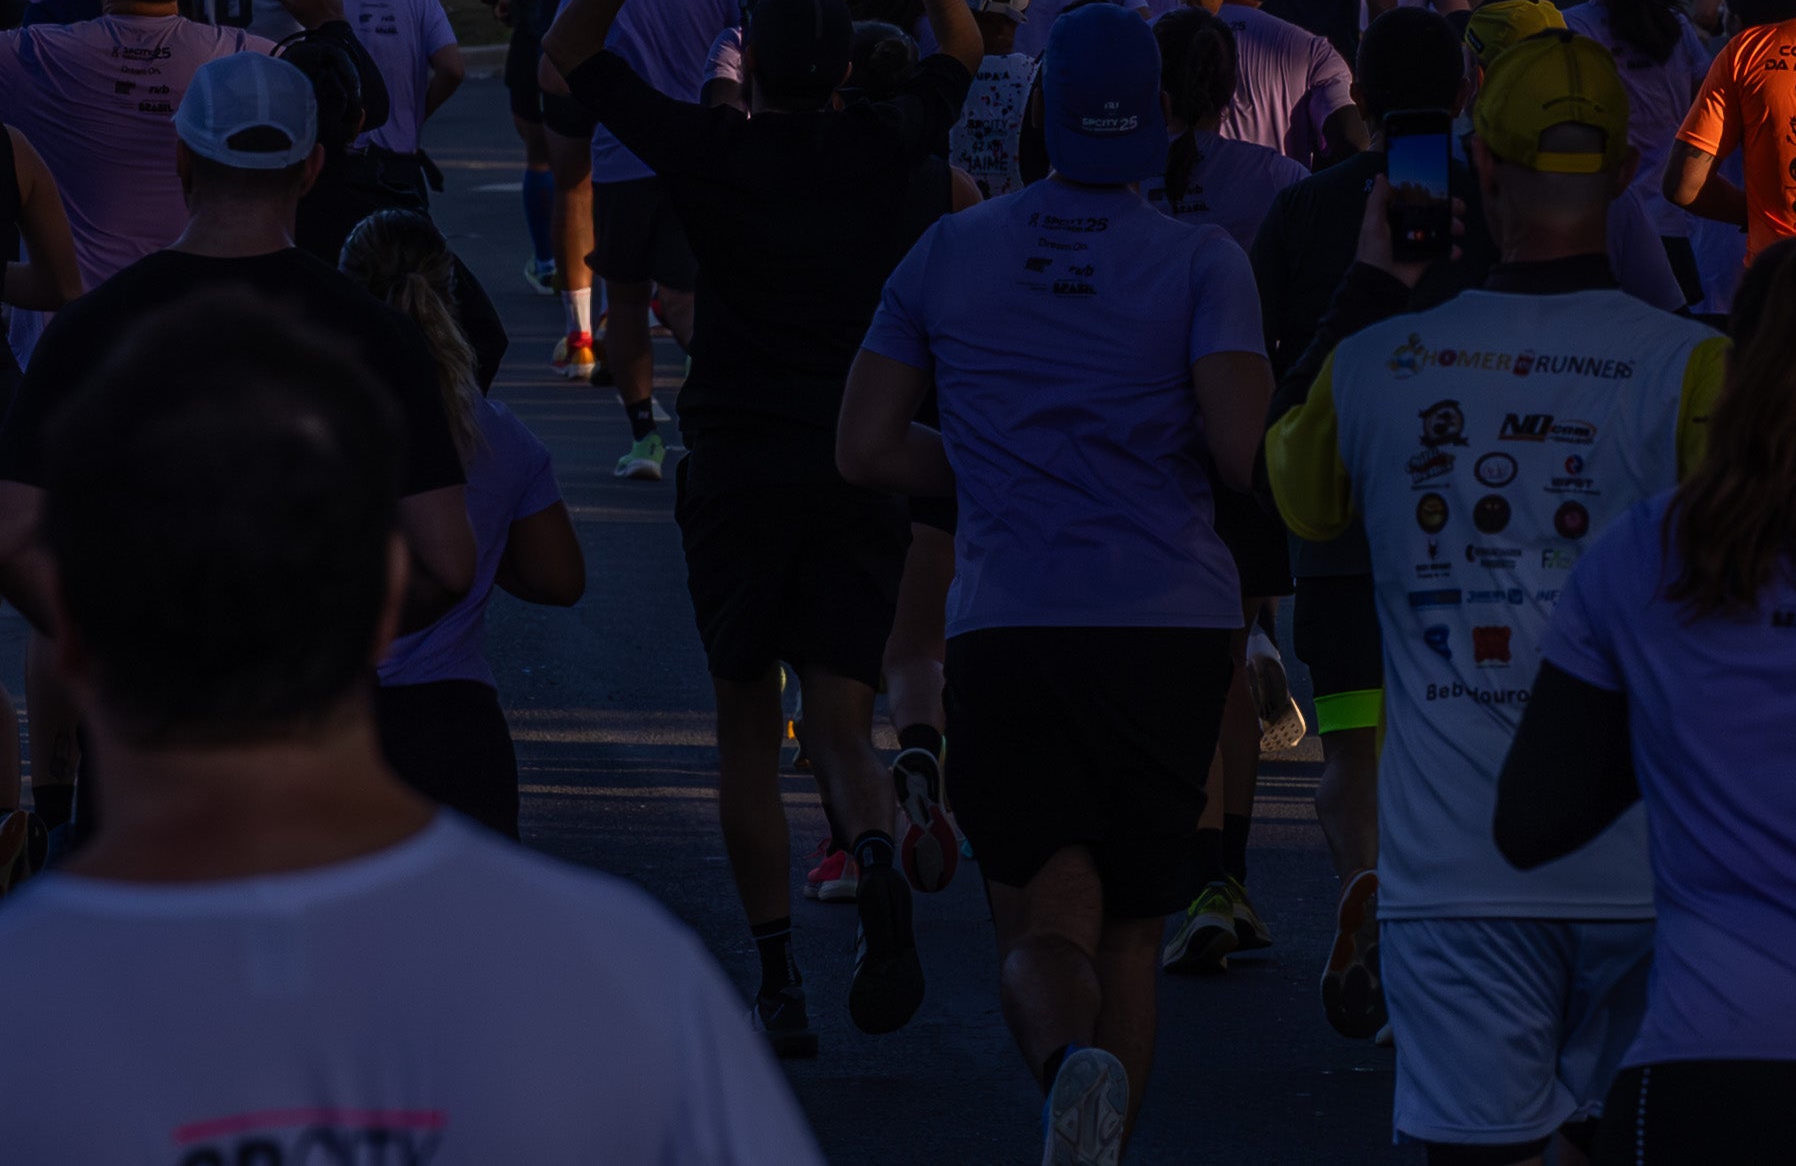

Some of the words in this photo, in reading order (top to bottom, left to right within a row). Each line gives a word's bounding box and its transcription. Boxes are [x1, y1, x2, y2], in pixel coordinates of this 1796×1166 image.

[1764, 59, 1788, 70] DA
[1081, 116, 1118, 127] SPCITY
[1119, 115, 1138, 131] 25
[1084, 217, 1109, 232] 25
[1423, 349, 1513, 371] HOMER
